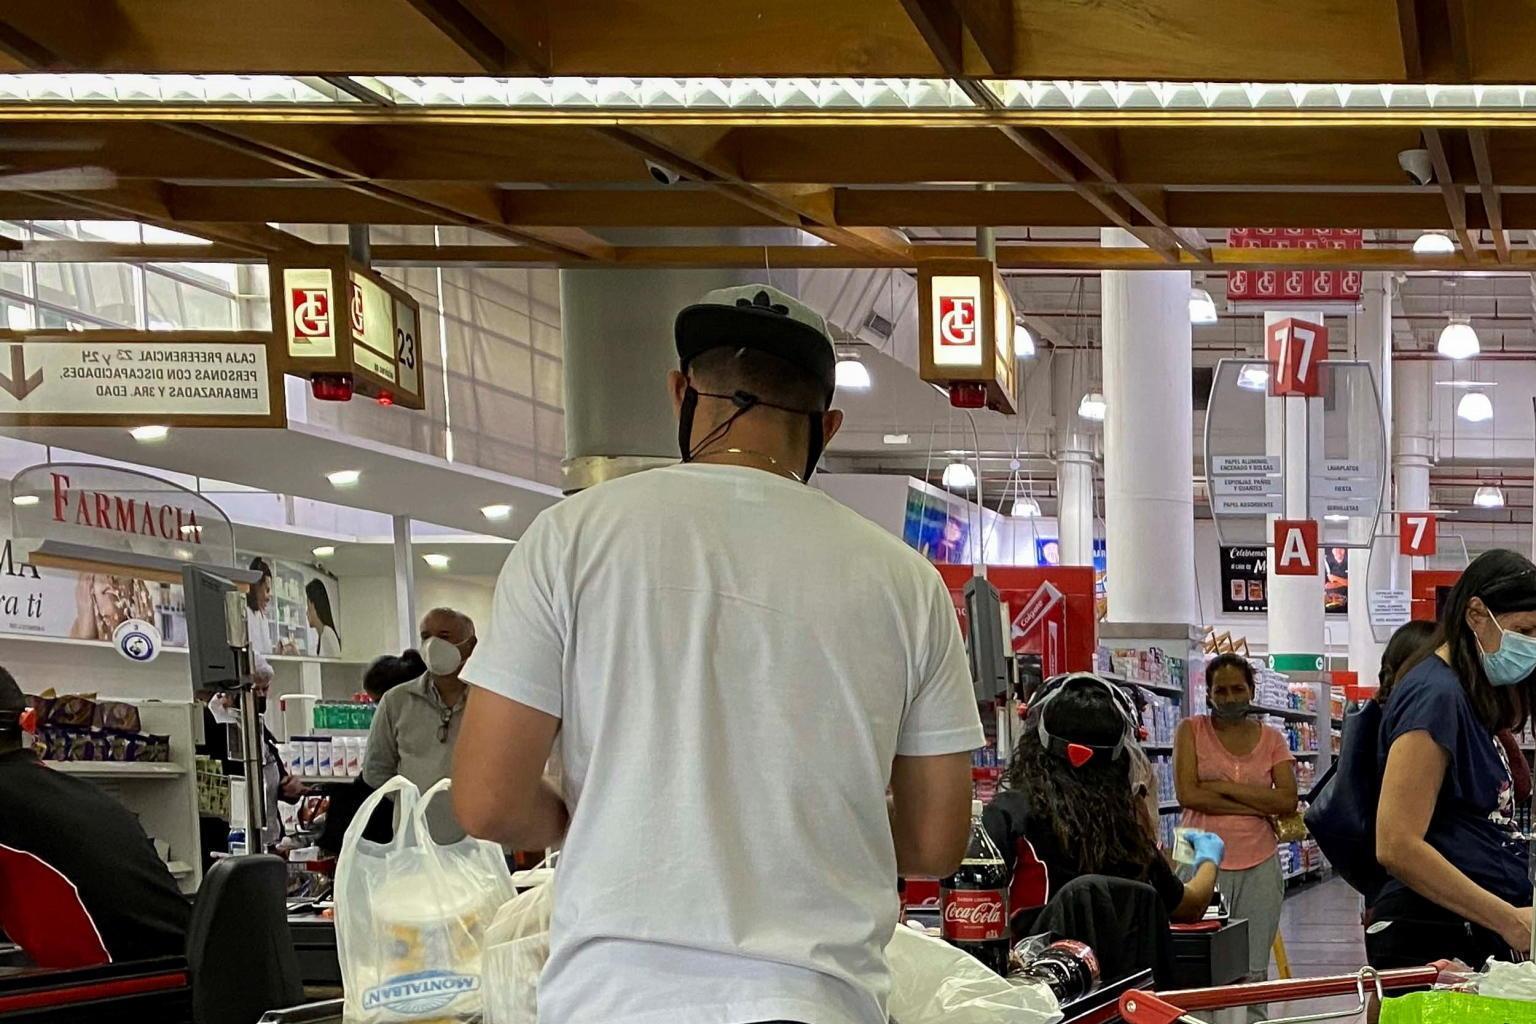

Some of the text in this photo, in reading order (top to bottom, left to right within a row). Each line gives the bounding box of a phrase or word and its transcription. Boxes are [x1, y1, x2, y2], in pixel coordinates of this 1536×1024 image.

[397, 328, 414, 370] 23
[50, 472, 202, 545] FARMACIA
[1279, 528, 1311, 567] A
[1406, 517, 1428, 550] 7
[1020, 600, 1044, 627] Colgate
